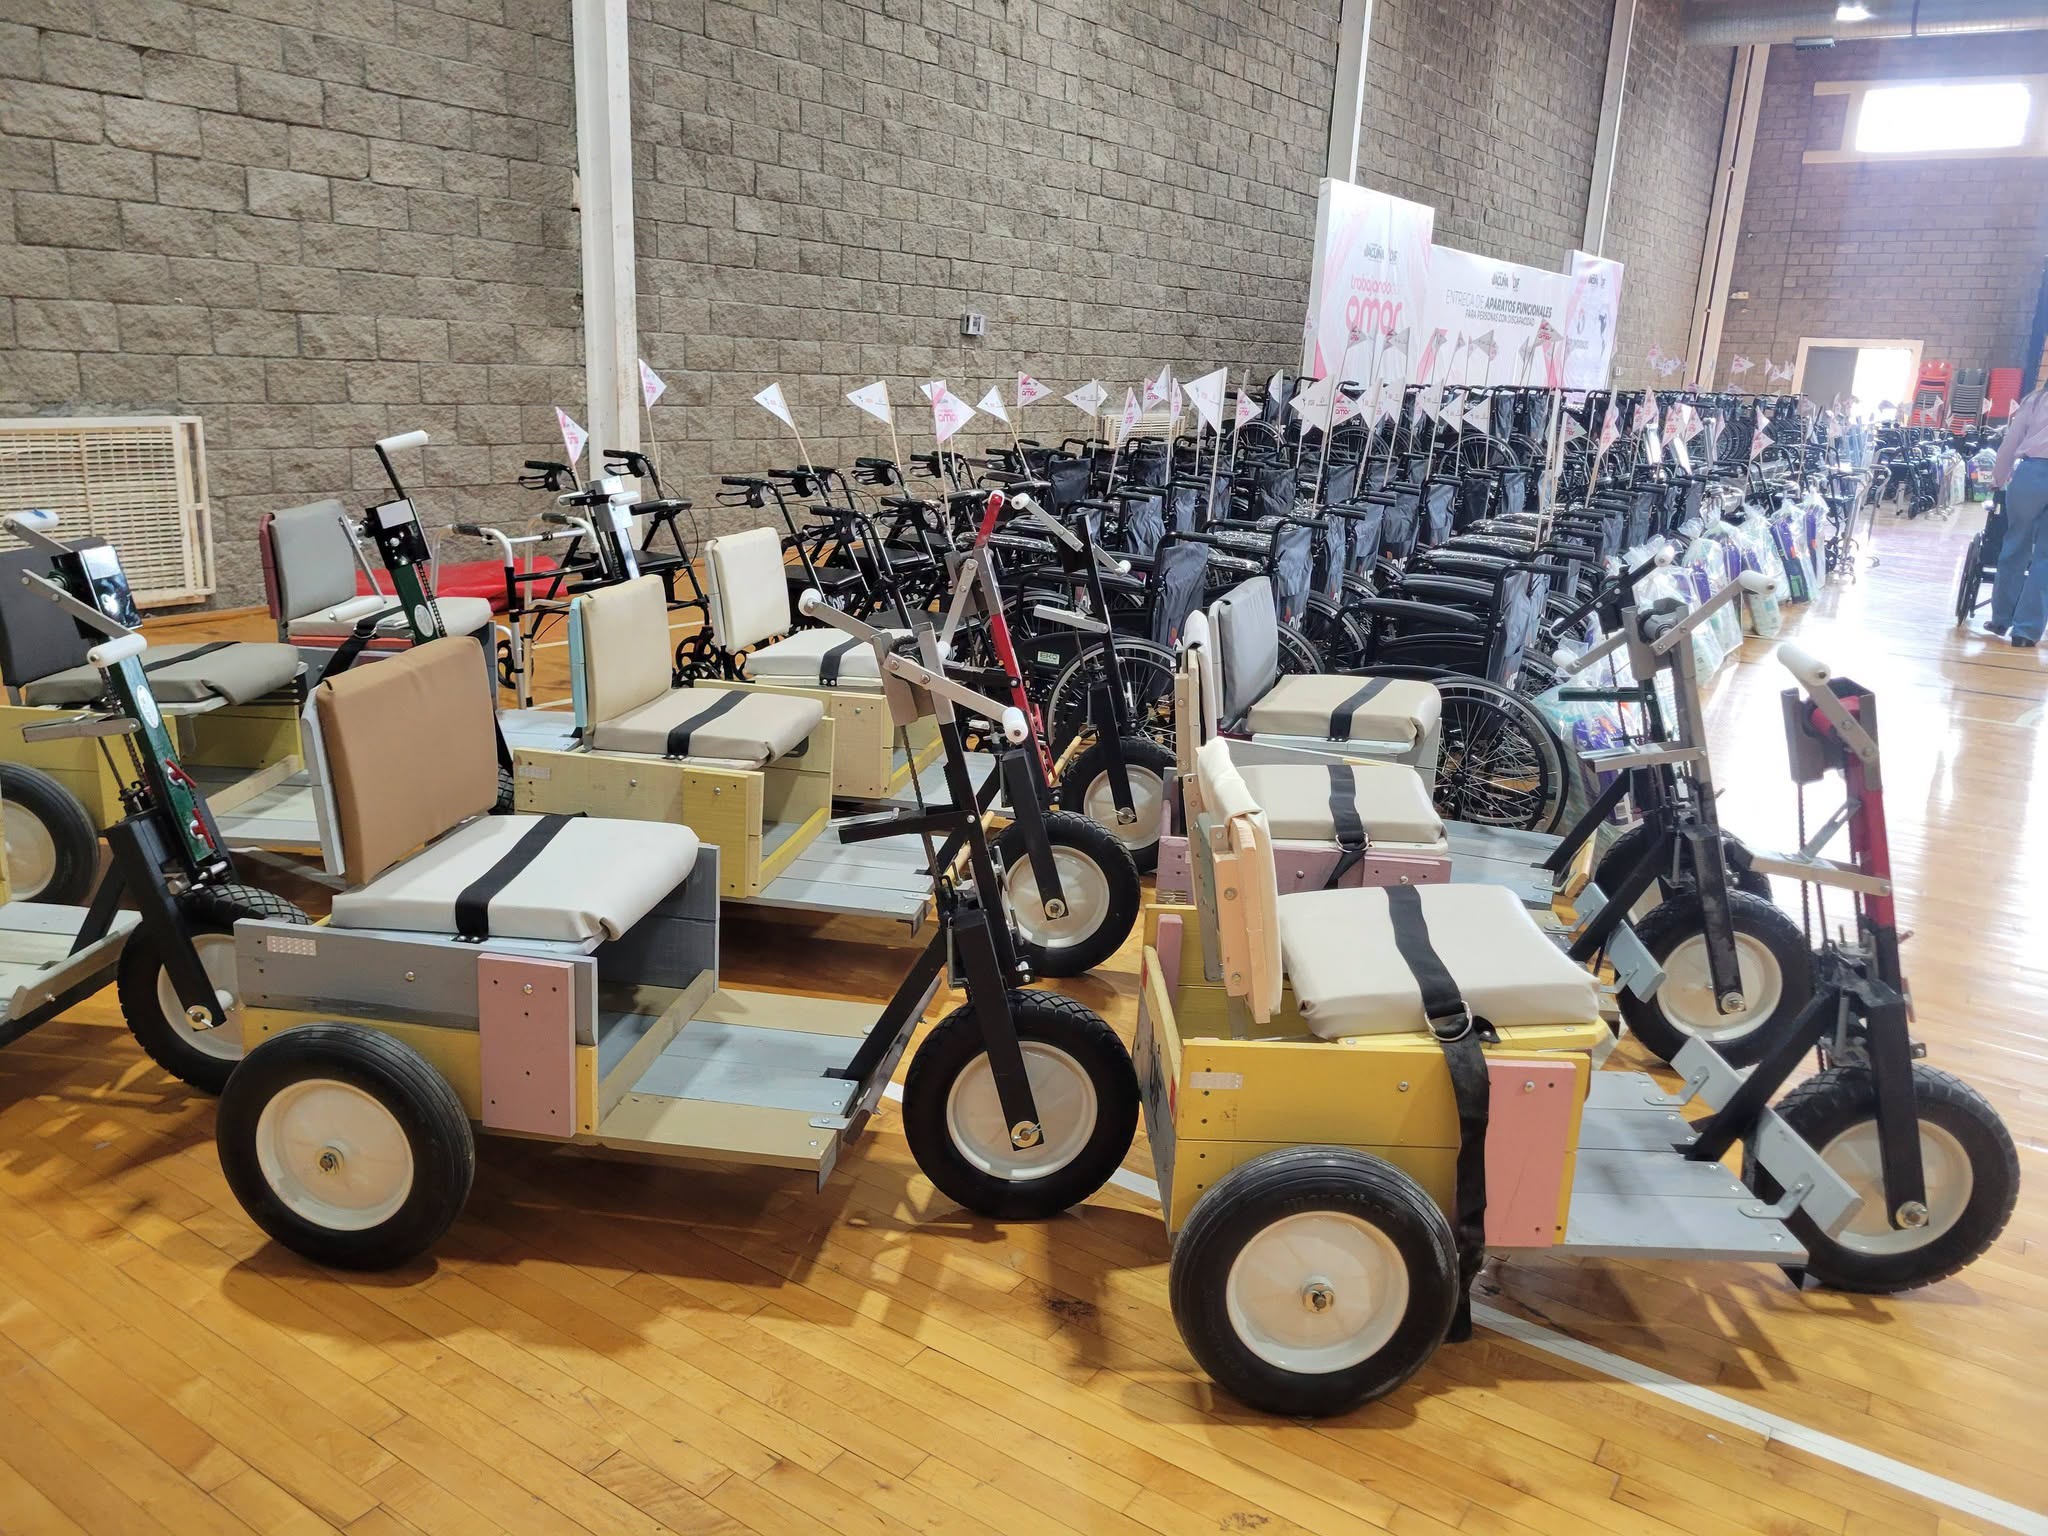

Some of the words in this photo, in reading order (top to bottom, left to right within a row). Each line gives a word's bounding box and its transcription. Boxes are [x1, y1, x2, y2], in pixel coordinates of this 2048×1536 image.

[1345, 295, 1402, 336] amor
[1445, 288, 1474, 307] ENTREGA
[1475, 294, 1485, 309] DE
[1485, 296, 1516, 313] APARATOS
[1515, 301, 1553, 319] FUNCIONALES
[1465, 308, 1476, 319] PARA
[1477, 310, 1498, 322] PERSONAS
[1498, 312, 1507, 323] CON
[1507, 314, 1535, 327] DISCAPACIDAD
